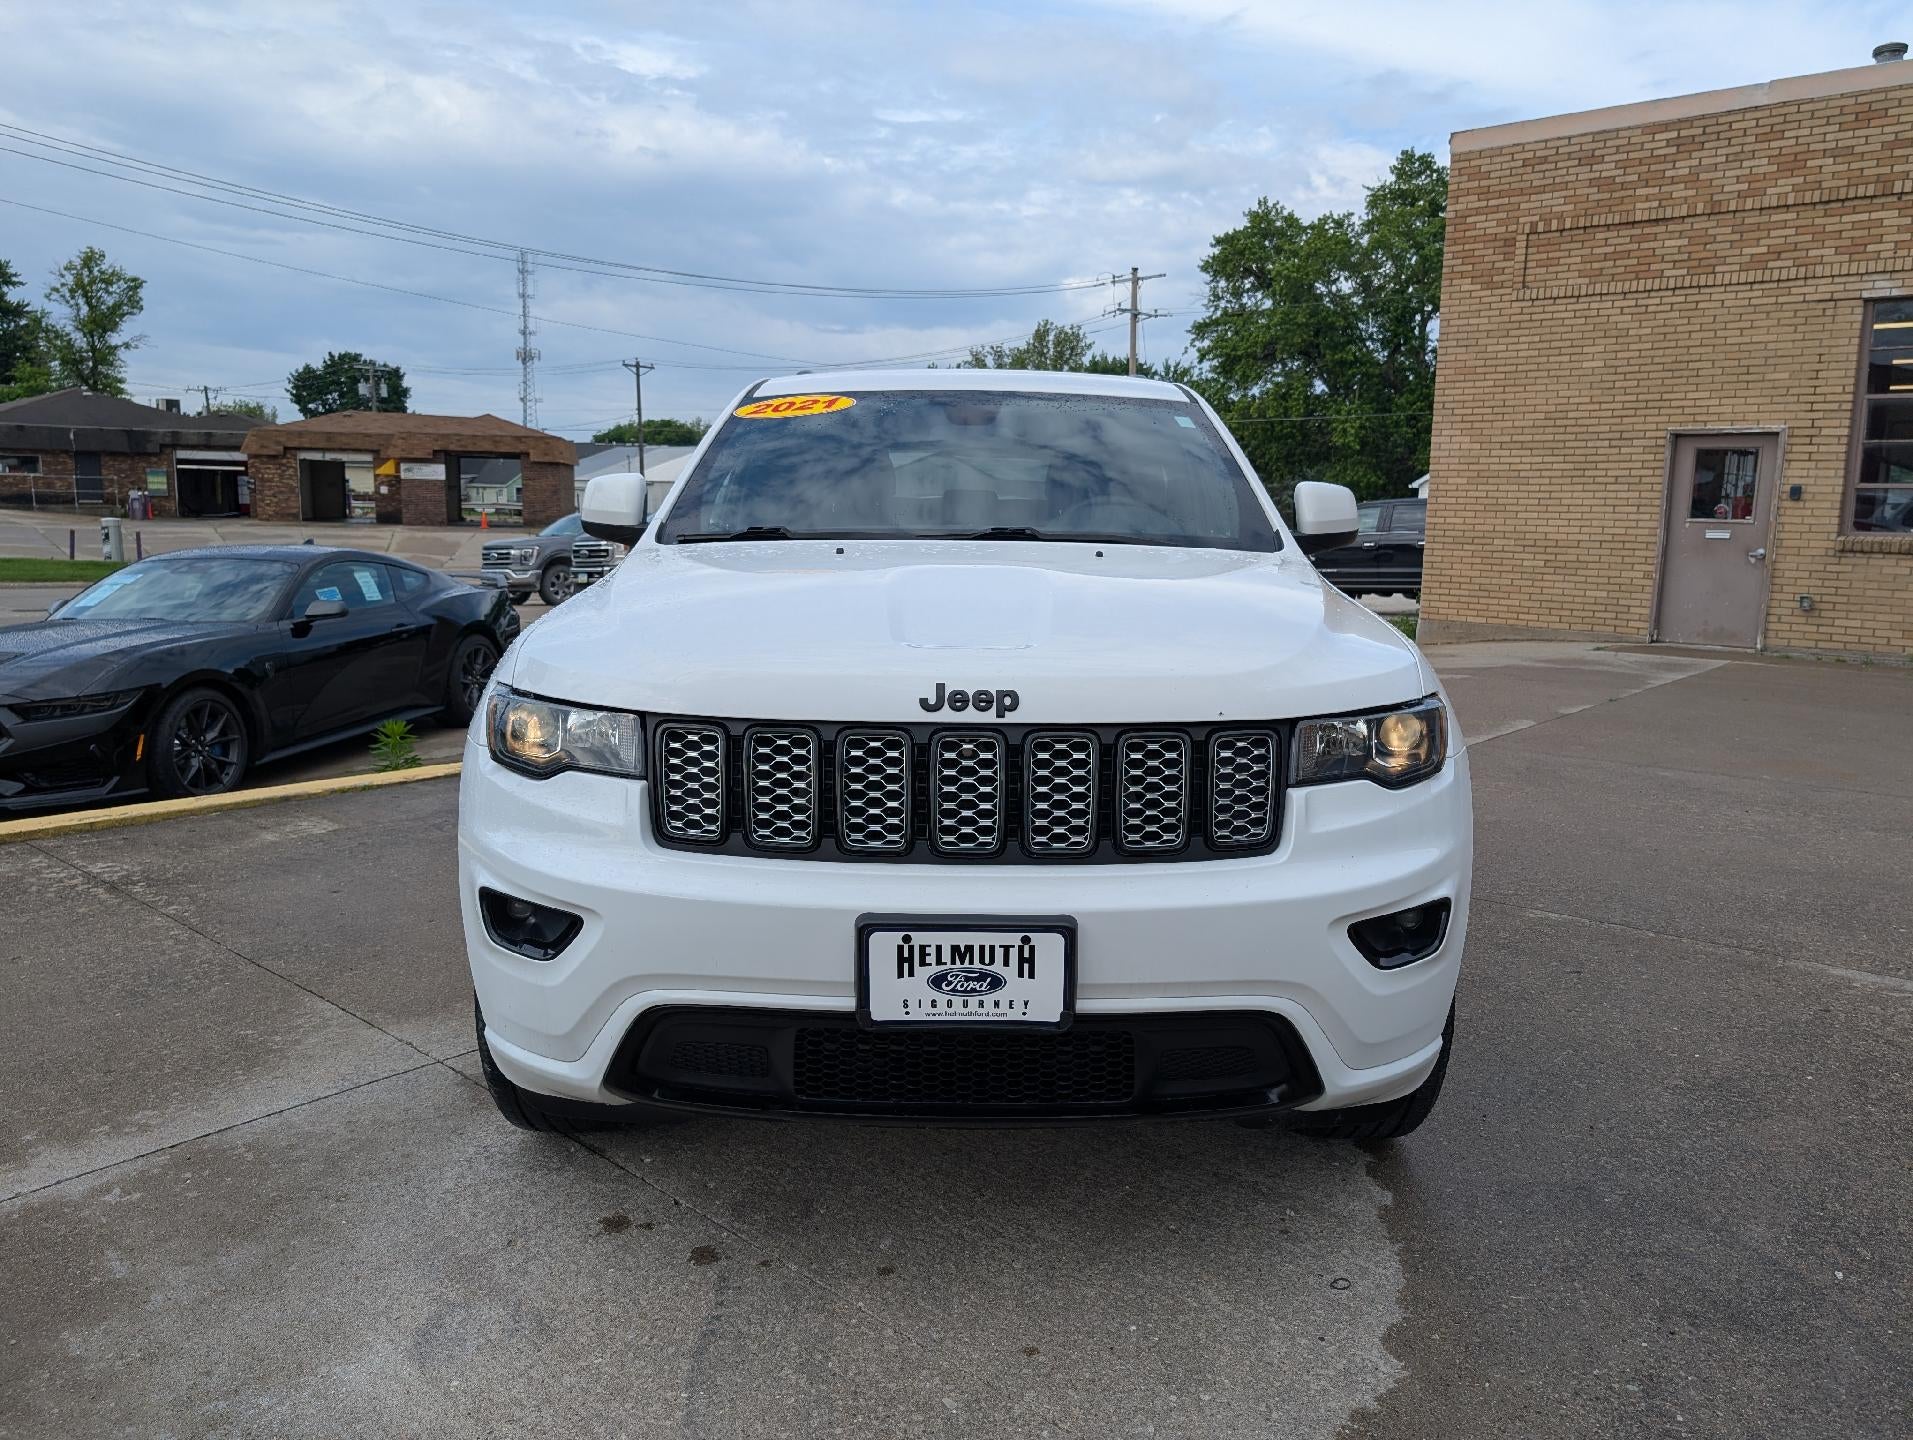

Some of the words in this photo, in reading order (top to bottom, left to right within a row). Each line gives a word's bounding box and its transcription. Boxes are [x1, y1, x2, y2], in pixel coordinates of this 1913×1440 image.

[744, 398, 841, 416] 2021
[919, 682, 1020, 718] Jeep
[897, 942, 1036, 979] HELMUTH
[942, 971, 991, 992] Ford
[902, 999, 1030, 1009] SIGOURNEY
